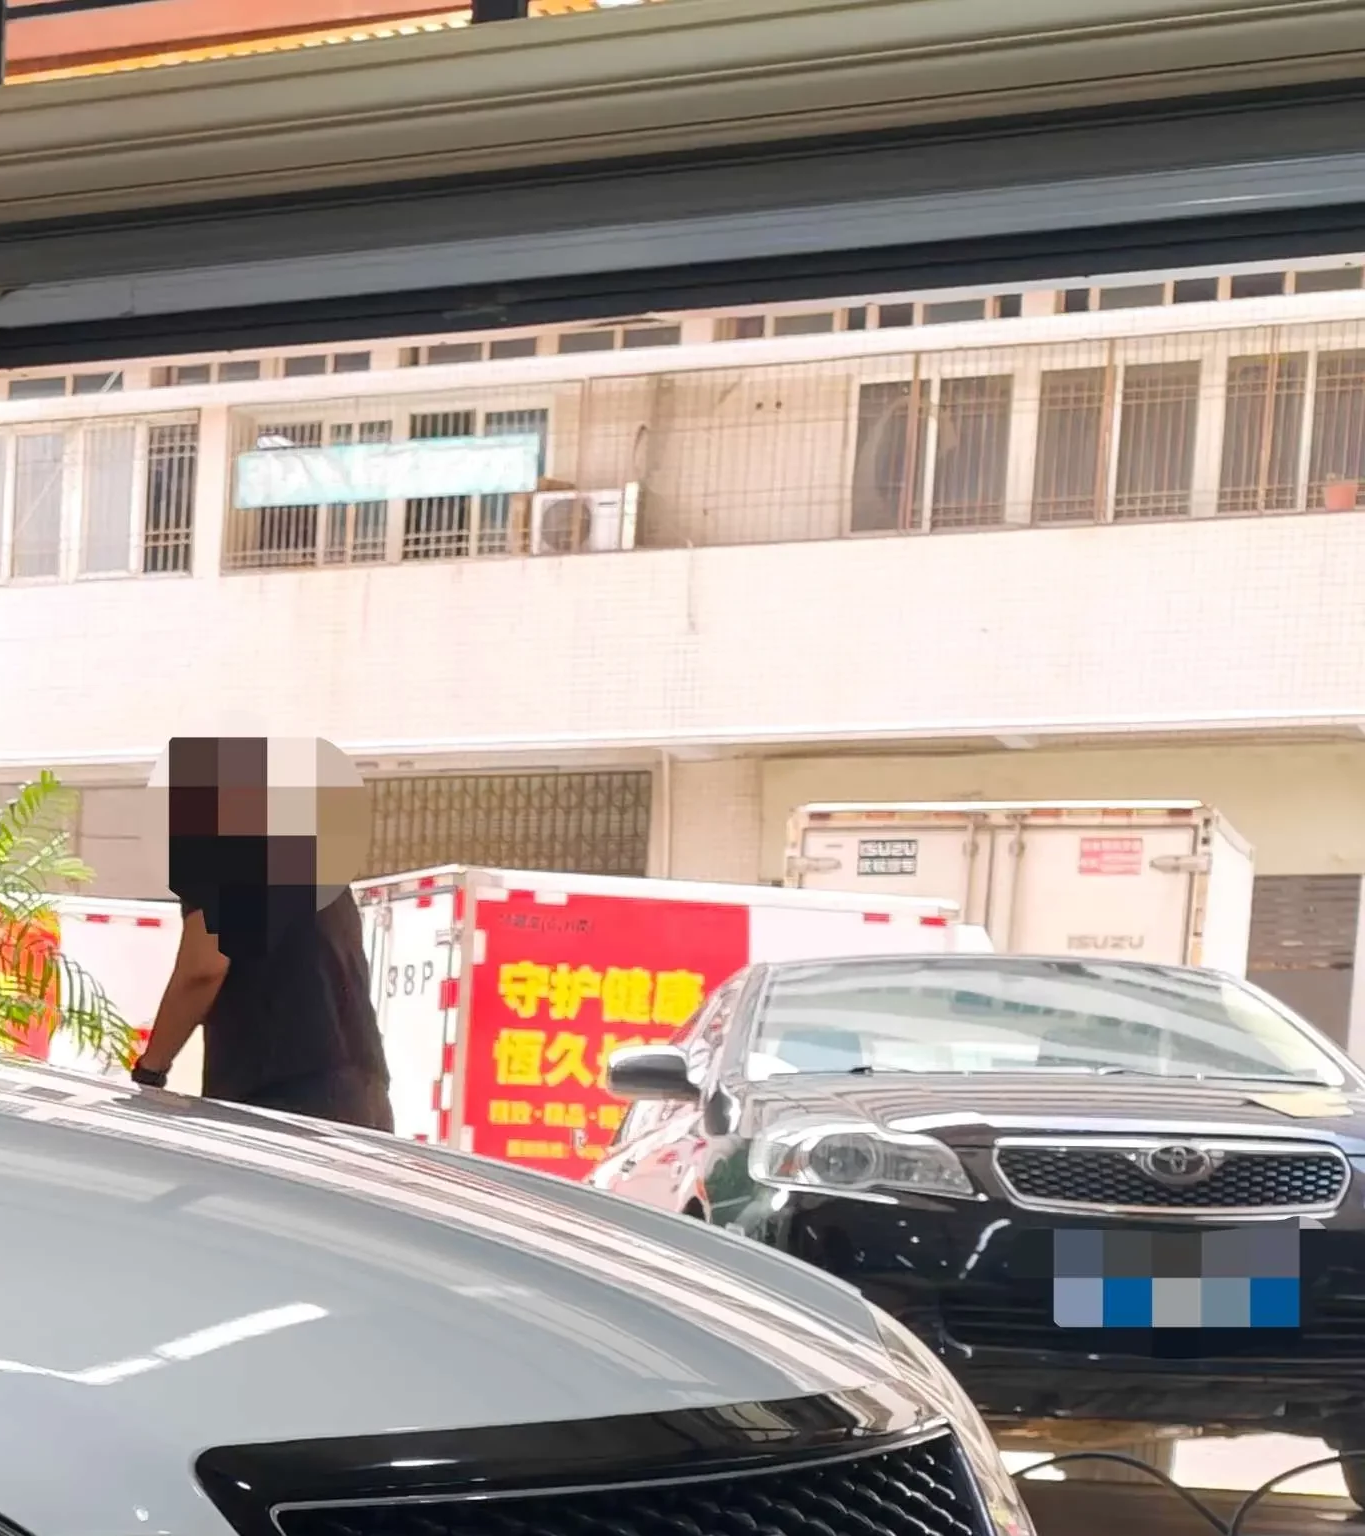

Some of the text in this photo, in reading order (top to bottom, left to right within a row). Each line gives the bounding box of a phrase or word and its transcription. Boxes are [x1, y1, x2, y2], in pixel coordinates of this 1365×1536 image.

[859, 841, 918, 857] ISUZU
[1067, 934, 1146, 950] ISUZU
[499, 960, 705, 1027] 守护健康
